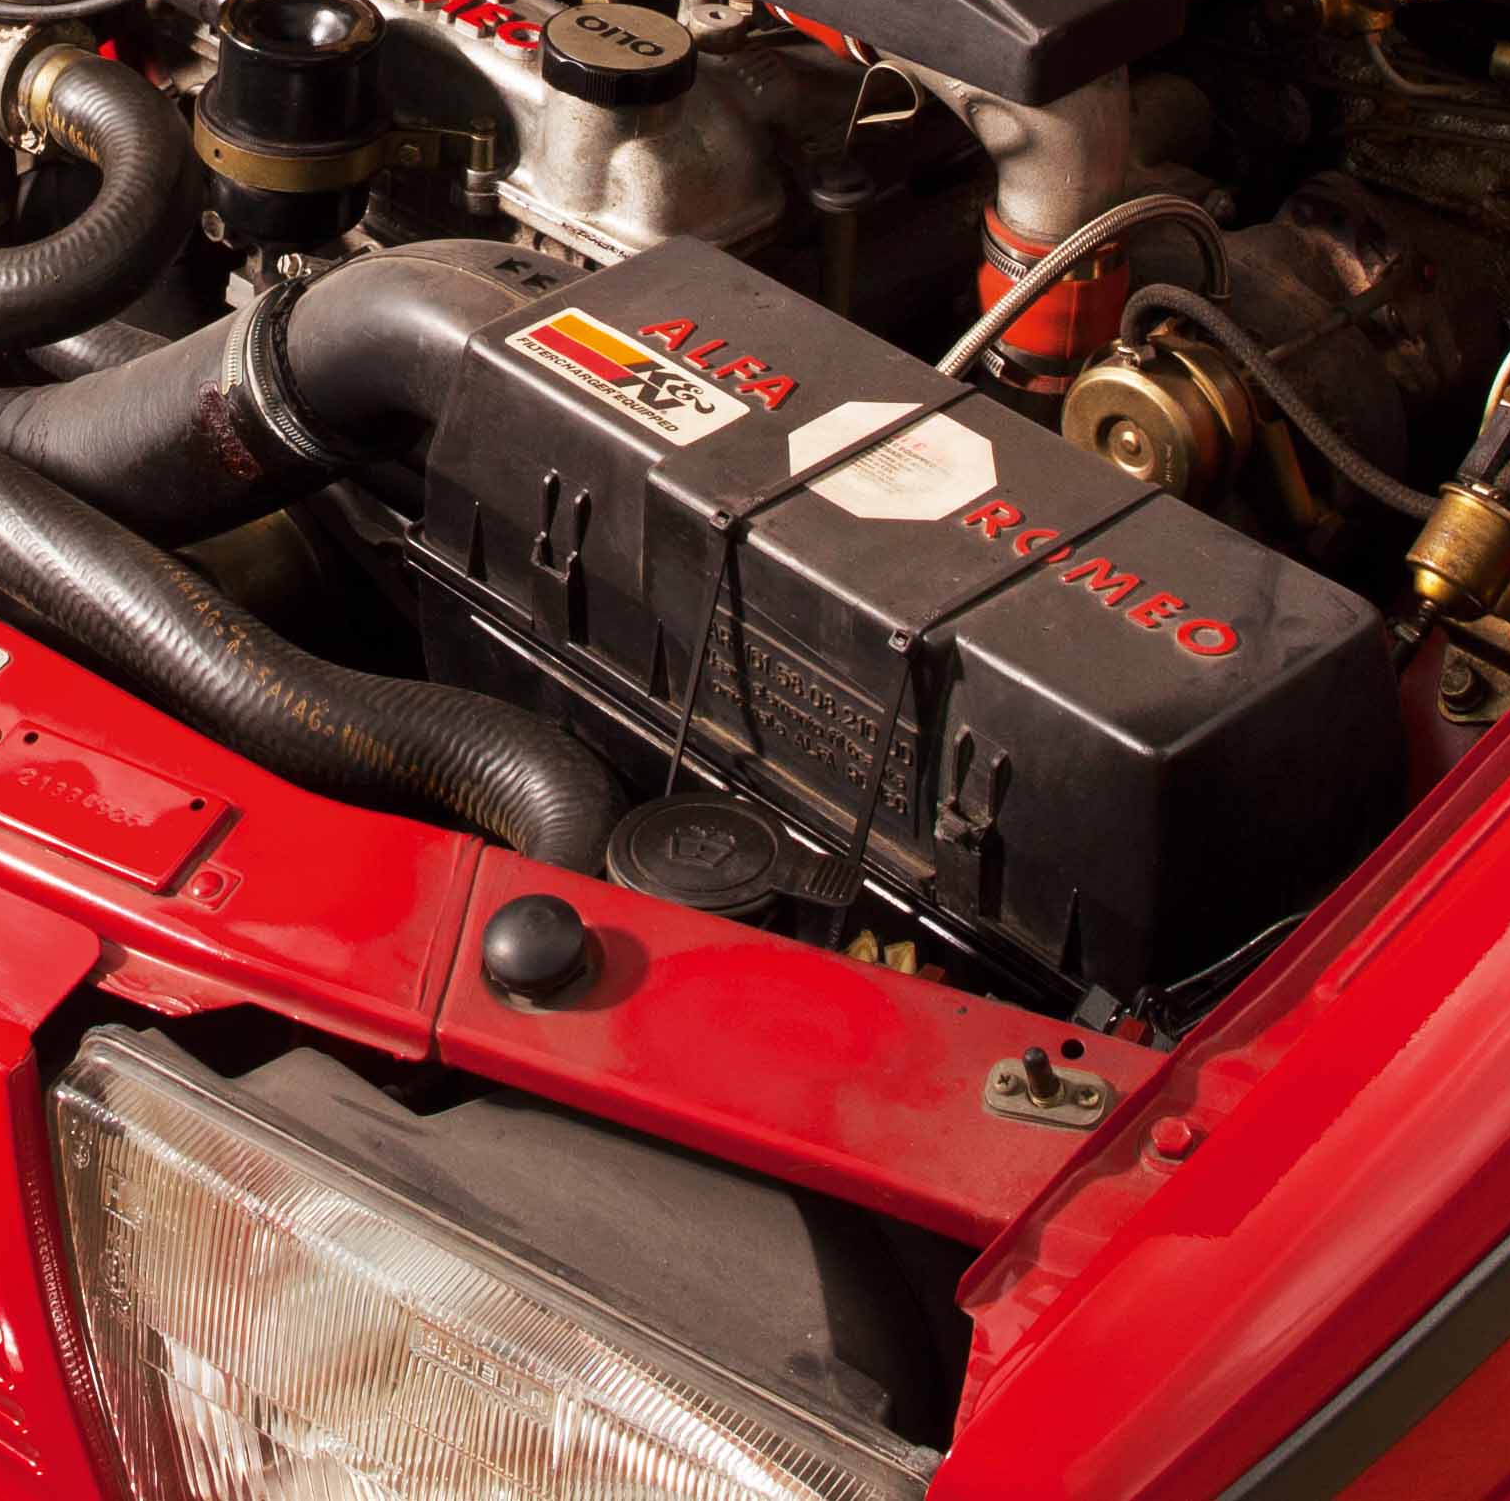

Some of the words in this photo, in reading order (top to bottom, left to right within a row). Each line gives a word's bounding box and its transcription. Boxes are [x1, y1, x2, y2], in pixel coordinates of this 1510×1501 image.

[575, 15, 665, 57] OLIO
[516, 336, 614, 395] FILTERCHARGER
[613, 392, 680, 433] EQUIPPED
[638, 318, 798, 411] ALFA
[962, 499, 1239, 657] ROMEO
